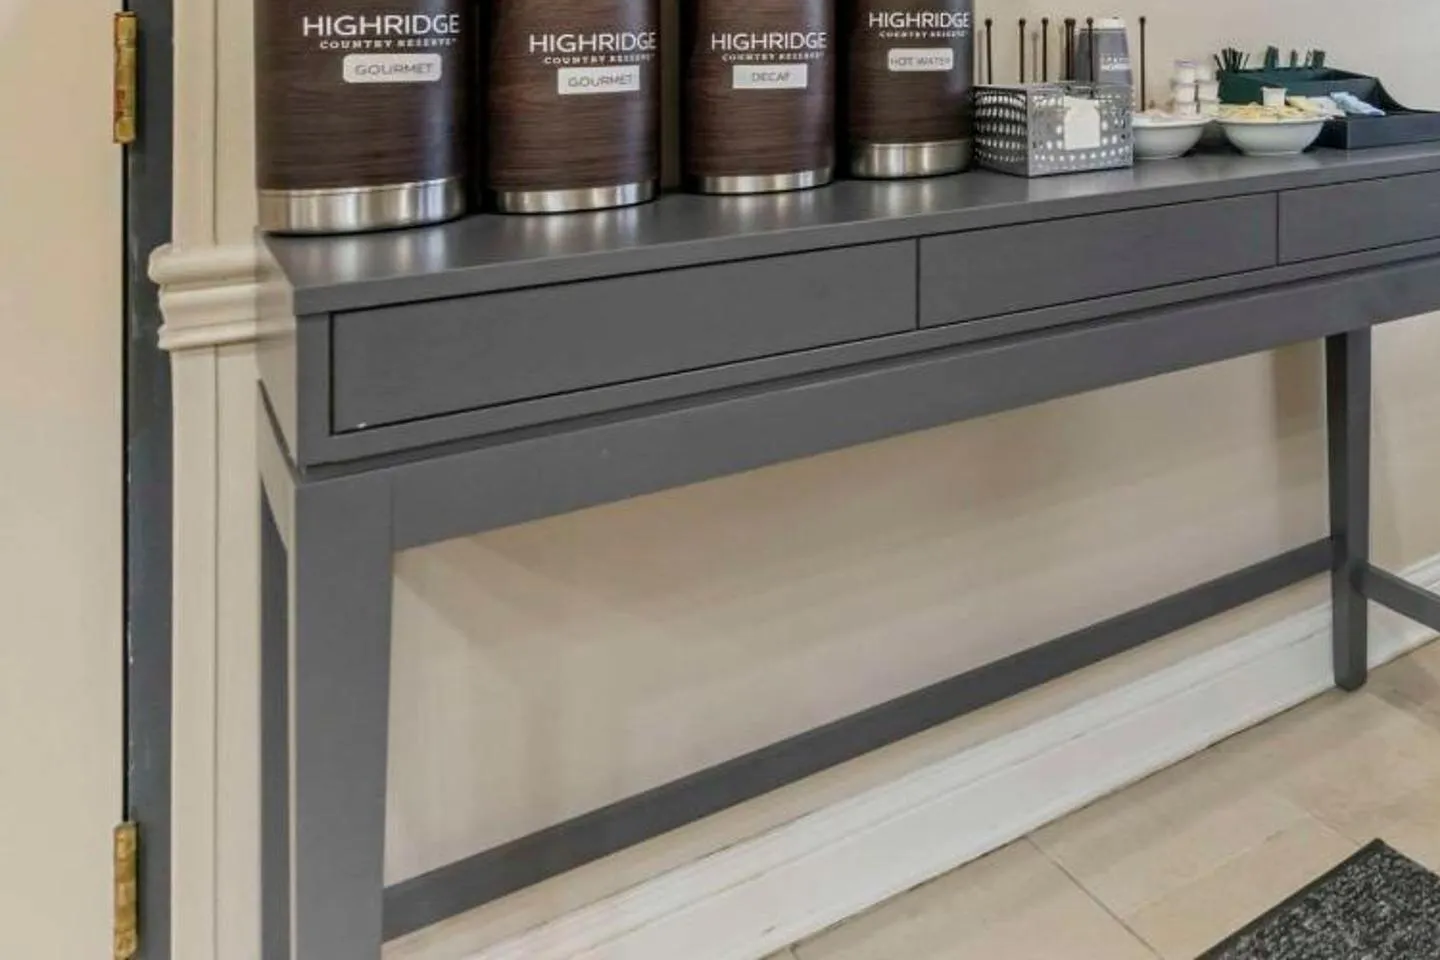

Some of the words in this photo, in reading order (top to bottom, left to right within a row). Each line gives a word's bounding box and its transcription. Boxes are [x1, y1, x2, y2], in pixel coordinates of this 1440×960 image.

[302, 14, 460, 37] HIGHRIDGE
[868, 11, 970, 29] HIGHRIDGE
[319, 40, 393, 50] COUNTRY
[528, 32, 657, 53] HIGHRIDGE
[711, 31, 827, 51] HIGHRIDGE
[354, 62, 435, 76] GOURMET
[567, 73, 632, 88] GOURMET
